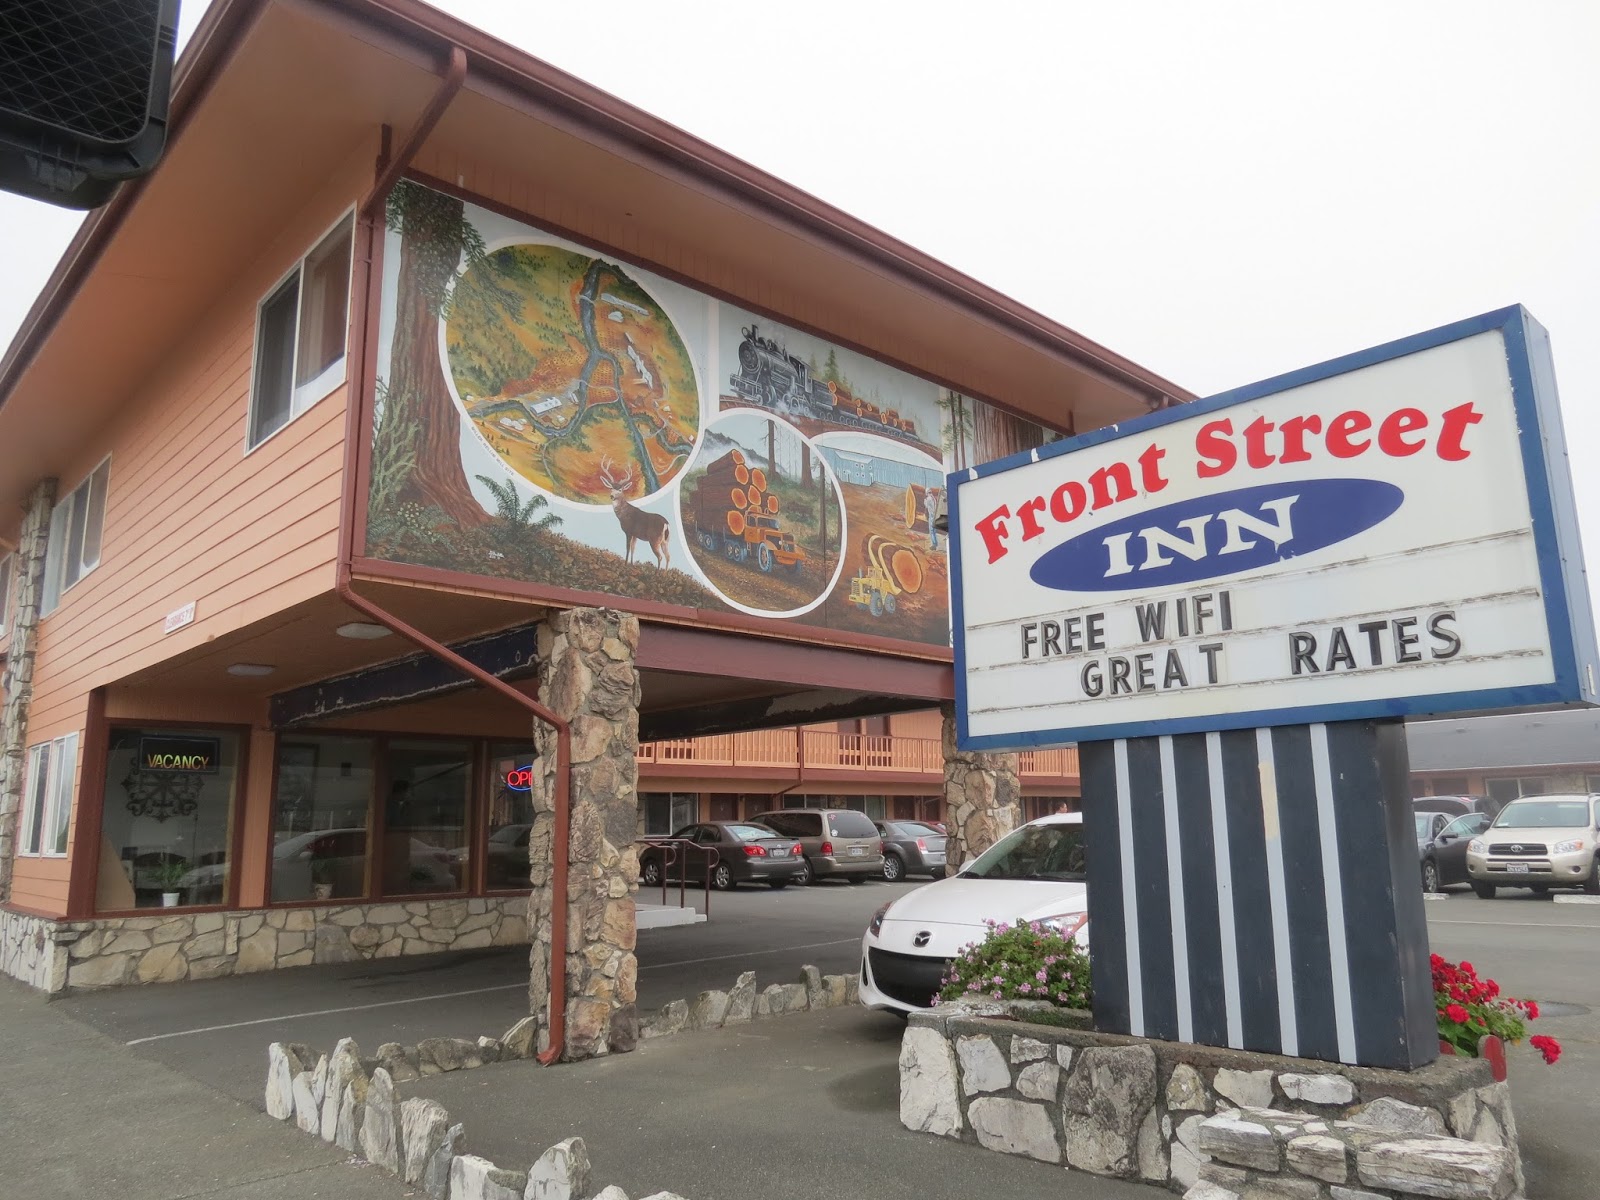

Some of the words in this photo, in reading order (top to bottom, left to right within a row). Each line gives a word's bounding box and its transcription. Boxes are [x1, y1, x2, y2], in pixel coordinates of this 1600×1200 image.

[975, 442, 1169, 565] Front
[1195, 401, 1484, 479] Street
[1101, 494, 1300, 578] INN
[1021, 612, 1106, 659] FREE
[1135, 590, 1233, 642] WIFI
[1080, 642, 1224, 698] GREAT
[1288, 611, 1462, 675] RATES
[147, 754, 209, 769] VACANCY
